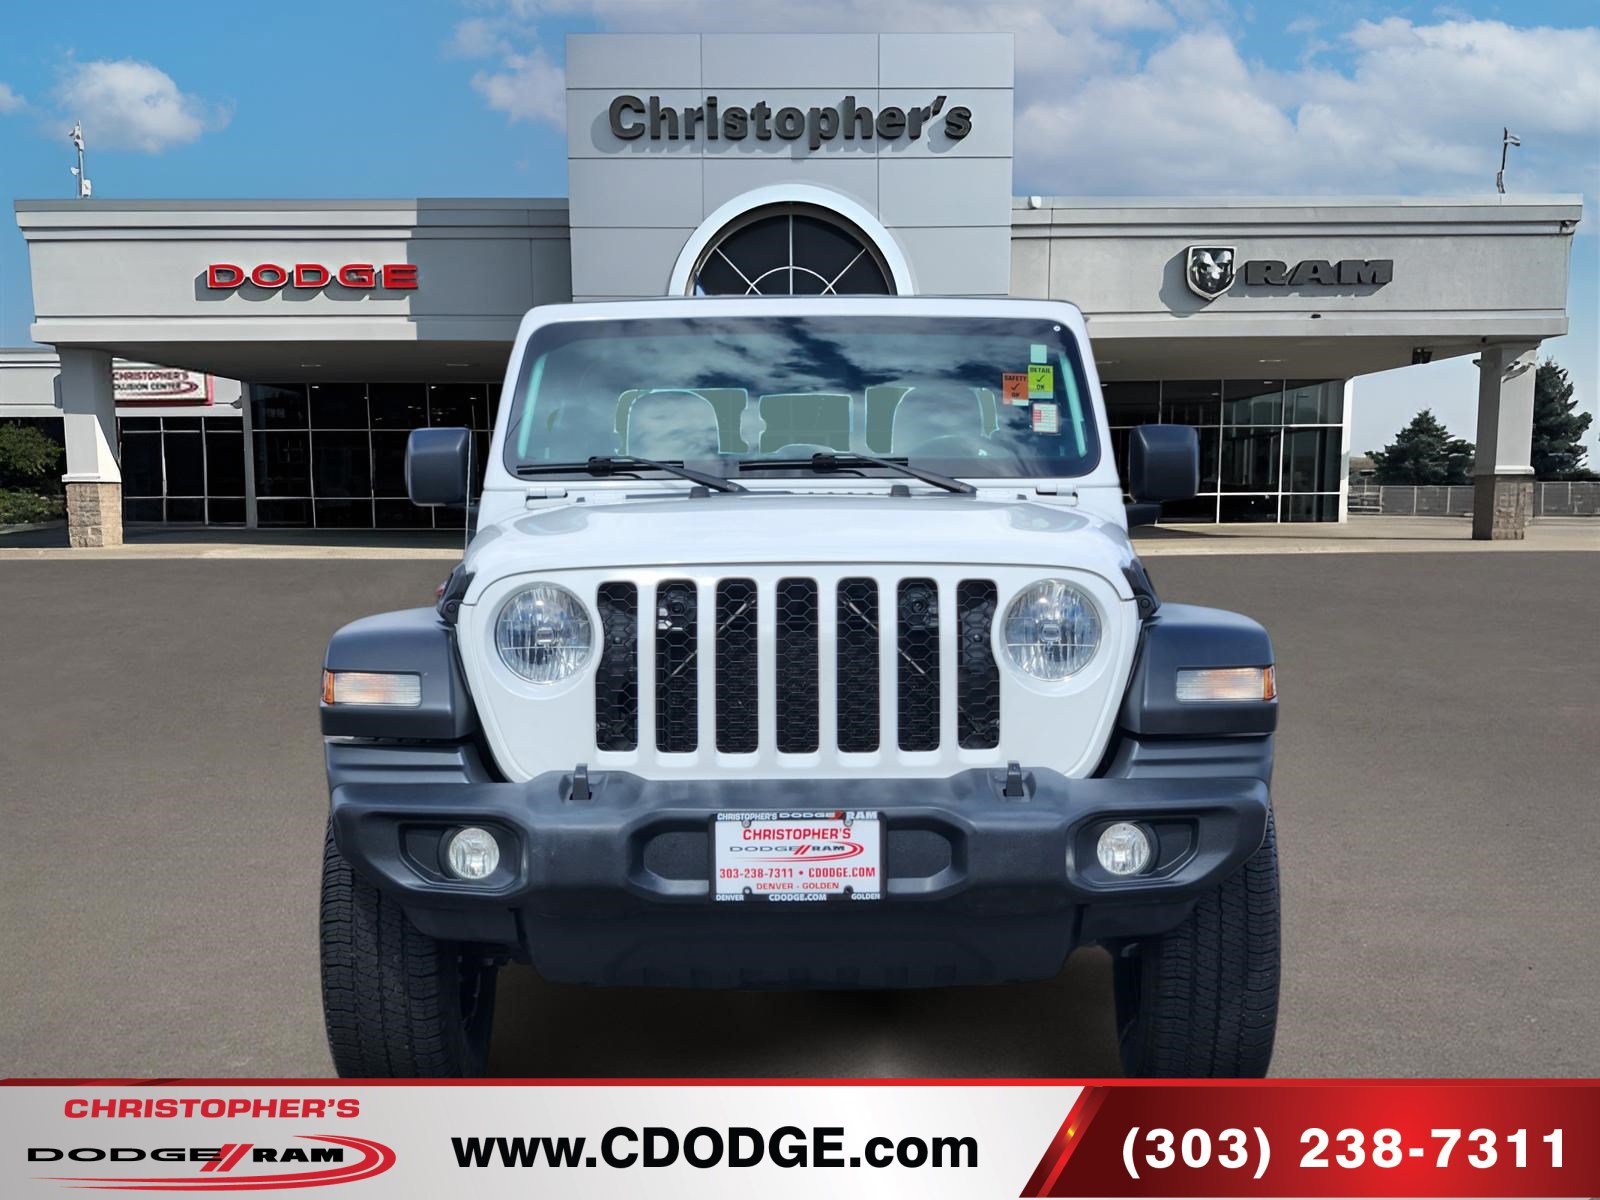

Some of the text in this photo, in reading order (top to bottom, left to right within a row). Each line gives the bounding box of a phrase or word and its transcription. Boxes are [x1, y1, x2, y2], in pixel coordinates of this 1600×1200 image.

[608, 95, 972, 150] Christopher's
[206, 263, 419, 289] DODGE
[1245, 259, 1393, 285] RAM
[150, 382, 181, 391] CENTER
[717, 812, 778, 821] CHRISTOPHER'S
[845, 811, 878, 820] RAM
[743, 828, 852, 841] CHRISTOPHER'S
[729, 845, 801, 853] DODGE
[719, 867, 876, 879] 303-238-7311 CDODGE.COM
[802, 882, 840, 890] GOLDEN
[716, 894, 745, 902] DENVER
[768, 894, 827, 902] CDODGE.COM
